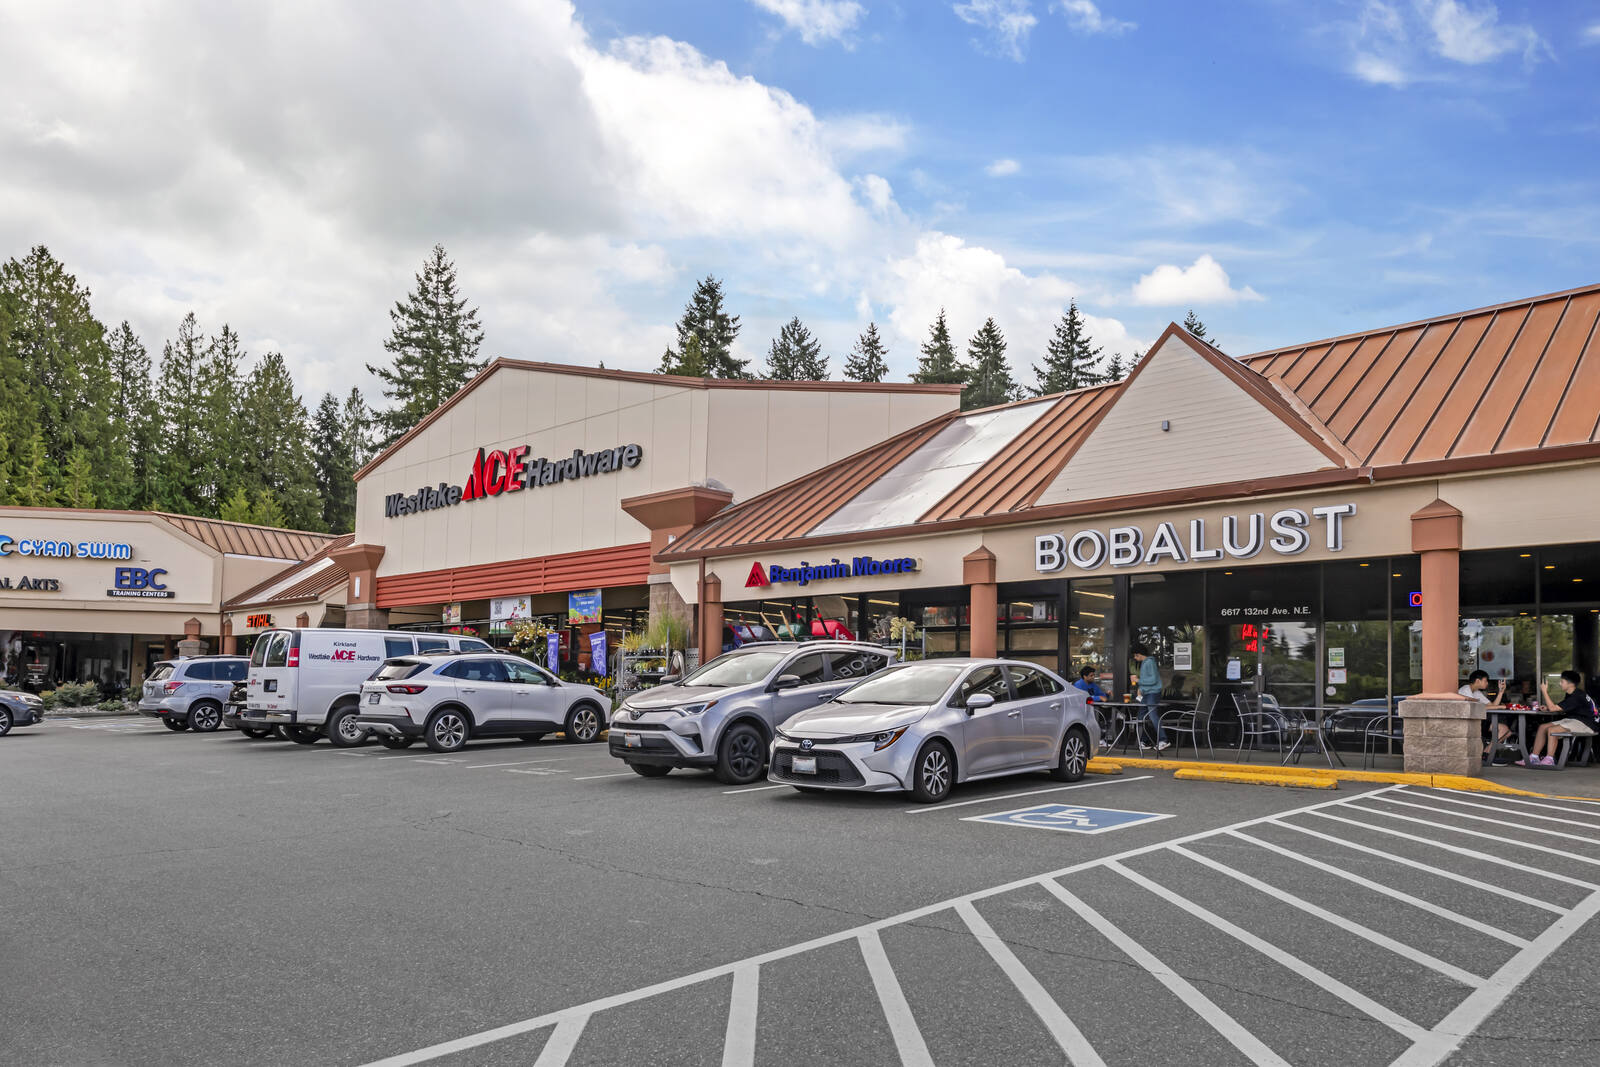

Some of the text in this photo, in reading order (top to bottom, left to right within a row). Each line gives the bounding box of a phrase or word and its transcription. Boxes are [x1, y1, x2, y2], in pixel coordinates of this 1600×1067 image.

[385, 443, 642, 517] Westlake ACE Hardware
[1035, 503, 1356, 573] BOBALUST
[18, 539, 133, 560] CYAN SWIM
[115, 567, 168, 590] EBC
[769, 556, 917, 586] Benjamin Moore
[246, 614, 272, 628] STIHL
[1221, 606, 1311, 616] 6617 132nd Ave. N.E.
[331, 648, 356, 661] ACE
